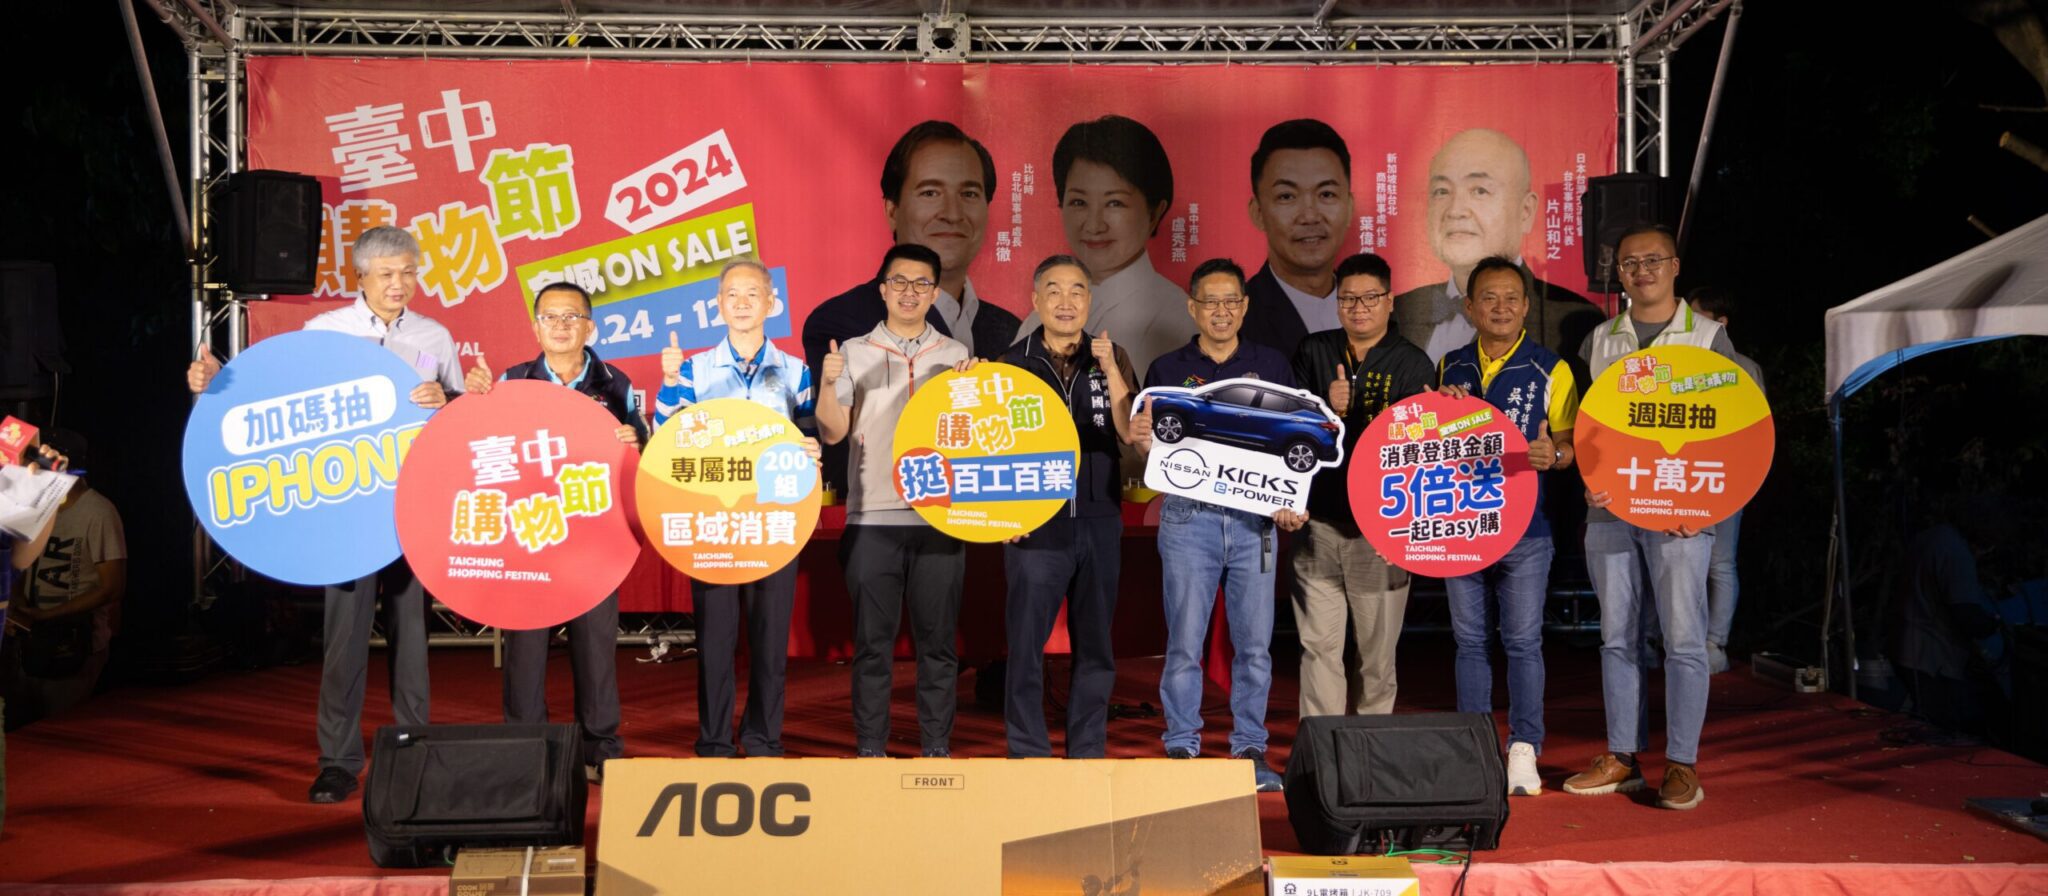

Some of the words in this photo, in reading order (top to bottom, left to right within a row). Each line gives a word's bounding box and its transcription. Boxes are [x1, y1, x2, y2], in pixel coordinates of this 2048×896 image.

[325, 88, 497, 194] 臺中
[615, 143, 733, 224] 2024
[1024, 163, 1034, 196] 比利時
[1171, 216, 1187, 263] 盧秀燕
[1188, 202, 1200, 246] 臺中市長
[1546, 199, 1561, 260] 片山和之
[605, 243, 662, 288] ON
[667, 221, 752, 272] SALE
[947, 372, 1013, 410] 臺中
[243, 384, 374, 448] 加碼抽
[936, 395, 1045, 456] 購物節
[1392, 402, 1423, 422] 臺中
[1457, 419, 1471, 431] ON
[1471, 411, 1493, 425] SALE
[1628, 402, 1716, 429] 週週抽
[468, 429, 568, 487] 臺中
[764, 451, 808, 471] 200
[1381, 433, 1503, 468] 消費登錄金額
[671, 456, 753, 484] 專屬抽
[899, 452, 950, 502] 挺
[951, 460, 1073, 495] 百工百業
[1160, 459, 1211, 478] NISSAN
[1217, 464, 1299, 496] KICKS
[1616, 456, 1726, 494] 十萬元
[774, 474, 799, 498] 組
[1381, 459, 1504, 518] 5倍送
[1630, 497, 1674, 507] TAICHUNG
[450, 461, 612, 554] 購物節
[947, 508, 988, 519] TAICHUNG
[1629, 506, 1673, 516] SHOPPING
[1674, 508, 1711, 517] FESTIVAL
[661, 511, 798, 546] 區域消費
[1390, 512, 1500, 542] 一起Easy購
[449, 556, 505, 568] TAICHUNG
[693, 552, 734, 560] TAICHUNG
[693, 560, 733, 568] SHOPPING
[1405, 545, 1446, 553] TAICHUNG
[1405, 553, 1446, 561] SHOPPING
[1447, 554, 1482, 562] FESTIVAL
[448, 567, 503, 579] SHOPPING
[504, 570, 552, 582] FESTIVAL
[914, 777, 956, 787] FRONT
[635, 782, 811, 837] AOC
